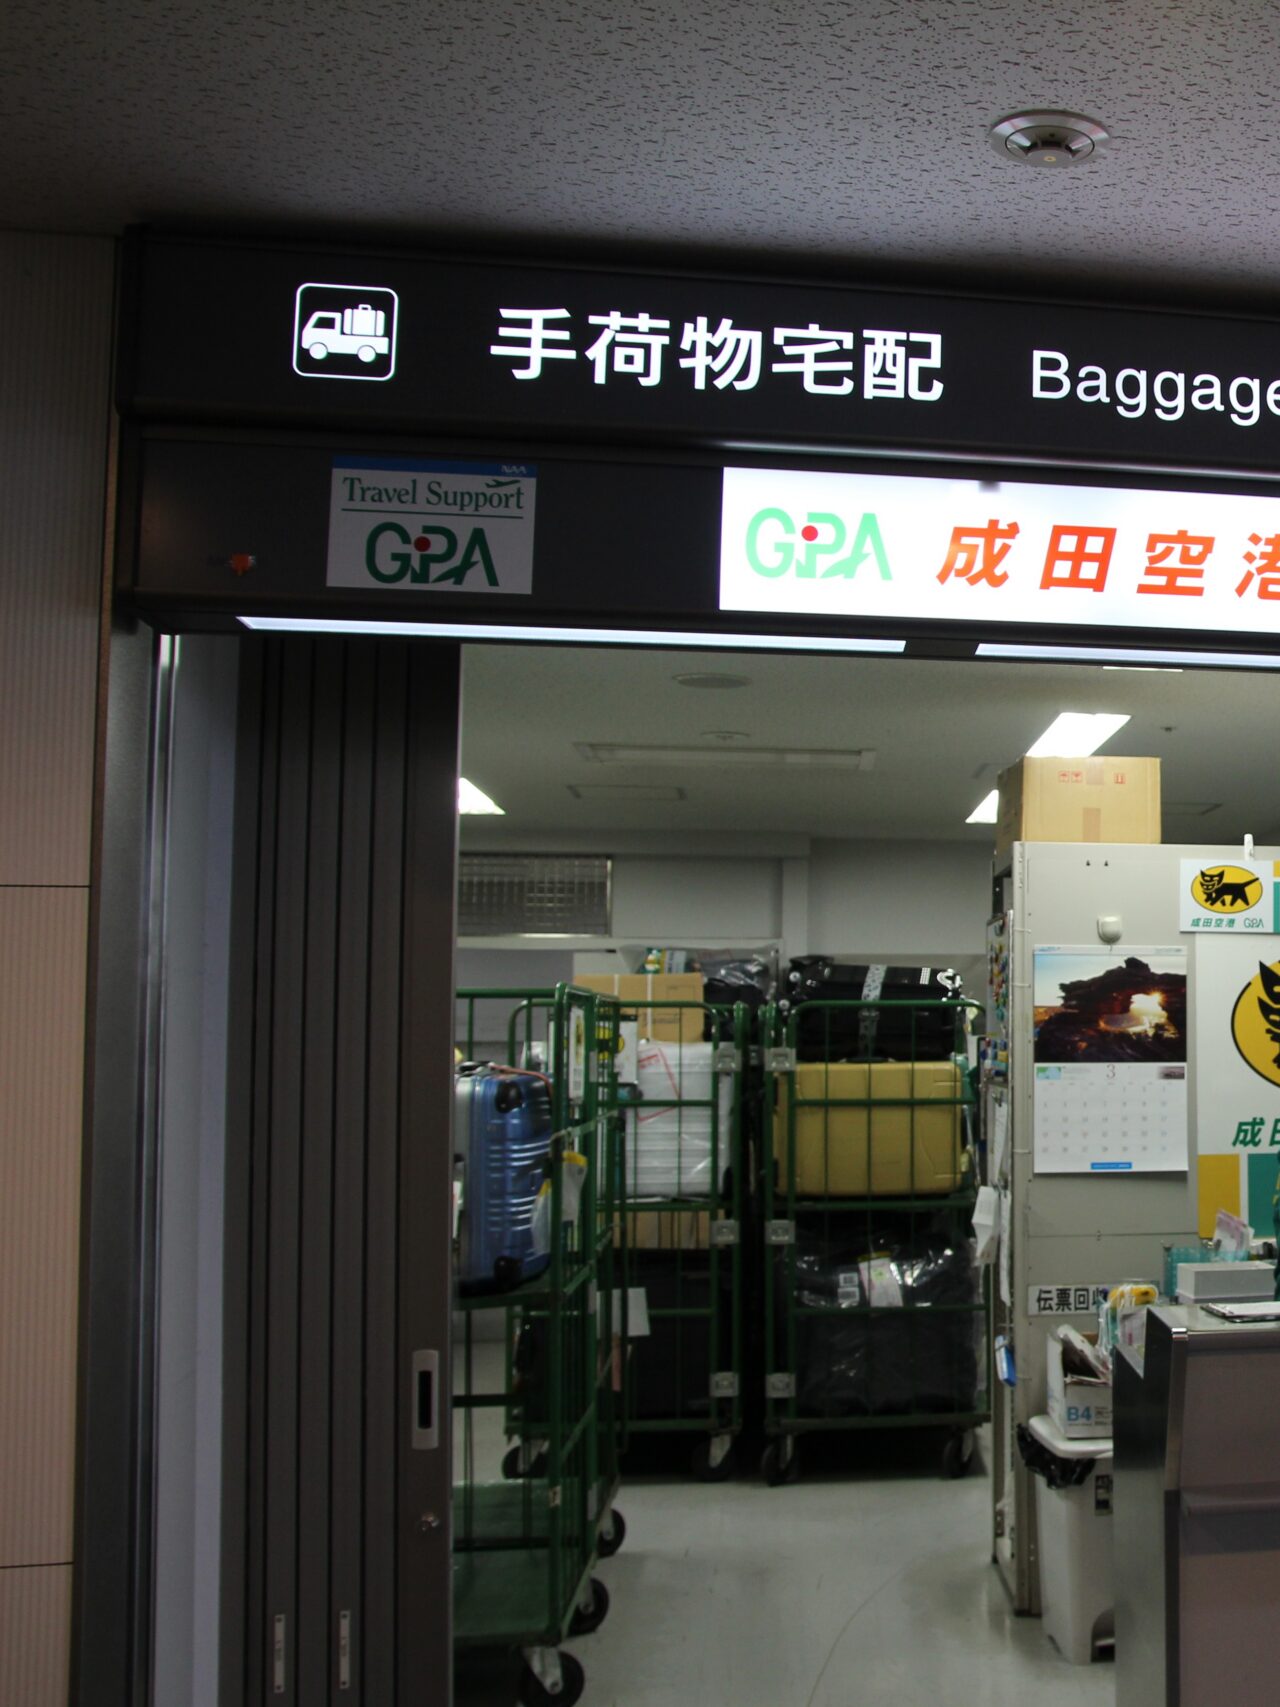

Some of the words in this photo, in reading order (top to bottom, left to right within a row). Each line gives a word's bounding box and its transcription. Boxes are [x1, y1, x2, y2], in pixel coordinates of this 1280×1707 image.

[490, 307, 944, 402] 手荷物宅配
[343, 476, 417, 505] Travel
[426, 481, 524, 512] Support
[366, 521, 500, 587] GPA
[745, 506, 893, 581] GPA
[1190, 917, 1236, 929] 成田空港
[1105, 1063, 1117, 1080] 3
[1067, 1406, 1092, 1422] B4
